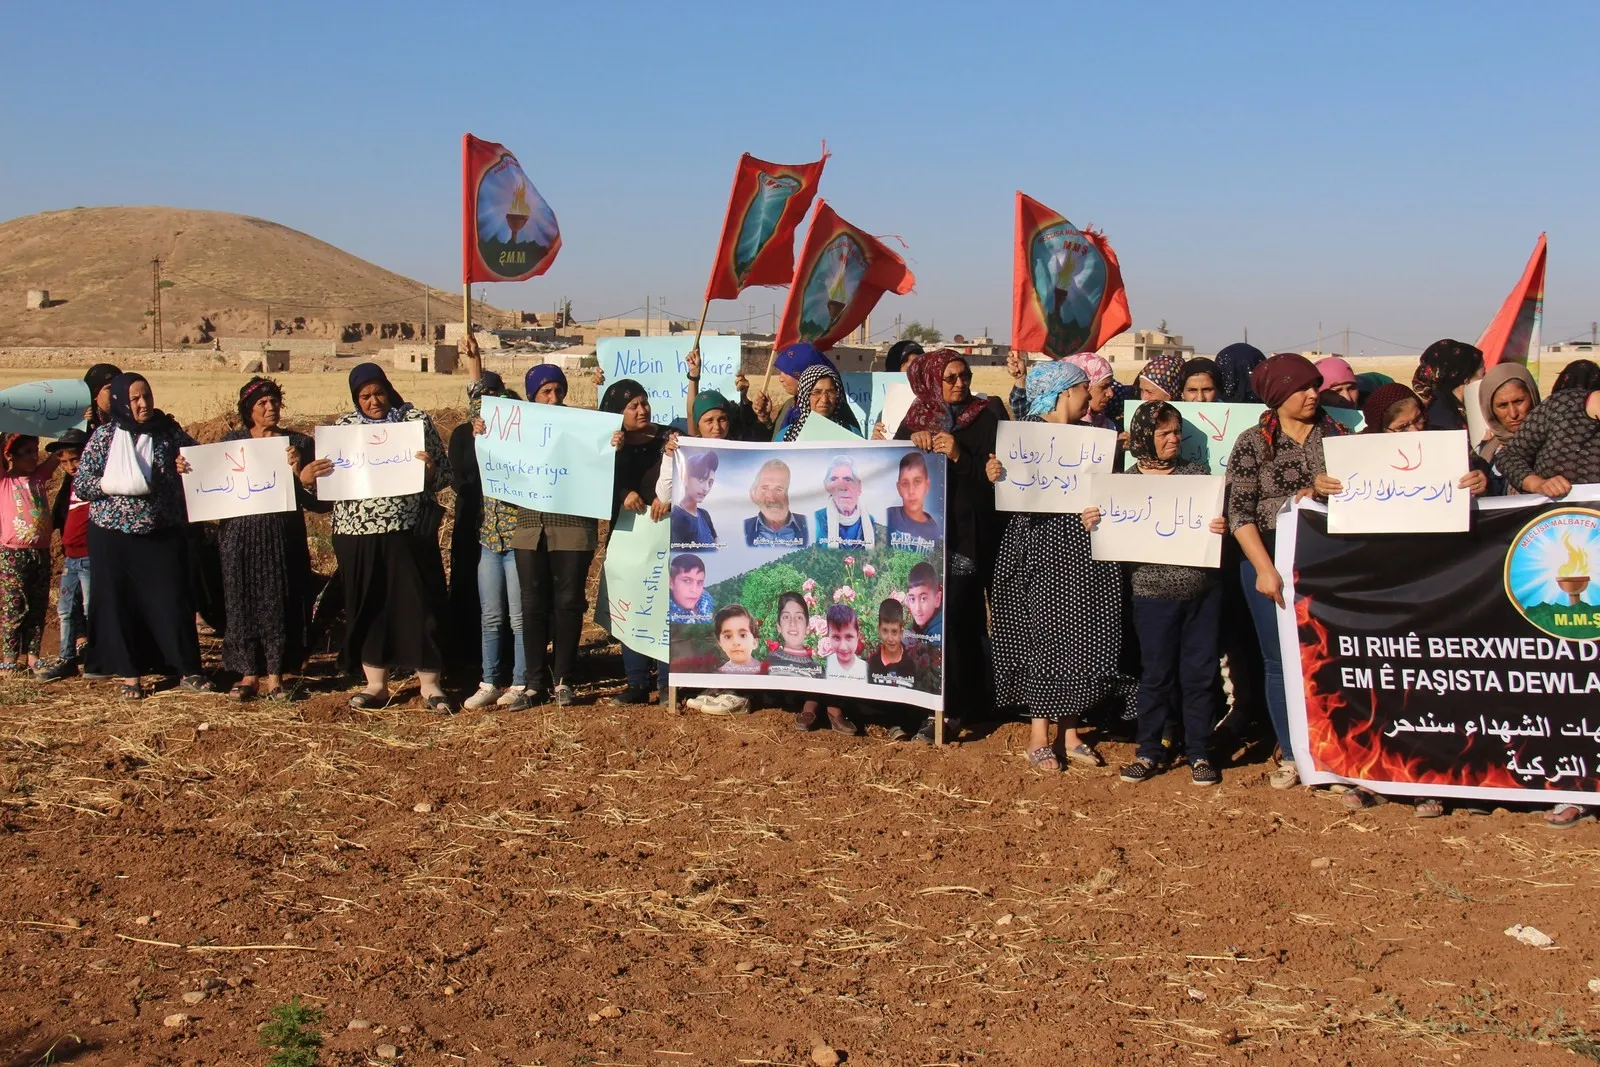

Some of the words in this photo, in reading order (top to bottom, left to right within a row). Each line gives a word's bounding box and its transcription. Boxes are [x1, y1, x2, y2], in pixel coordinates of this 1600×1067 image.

[613, 348, 664, 377] Nebin
[675, 350, 734, 375] hkarê
[367, 429, 388, 446] لا
[485, 404, 521, 442] NA
[539, 423, 553, 448] ji
[224, 446, 246, 473] لا
[485, 450, 570, 486] dagirkeriya
[1389, 440, 1423, 471] لا
[1155, 496, 1203, 537] قاتل
[1339, 635, 1360, 657] BI
[1366, 632, 1422, 658] RIHÊ
[1428, 637, 1575, 661] BERXWEDA
[1341, 667, 1374, 689] EM
[1379, 663, 1396, 690] Ê
[1401, 669, 1503, 696] FAŞISTA
[1465, 714, 1551, 743] الشهداء
[1506, 750, 1587, 783] التركية
